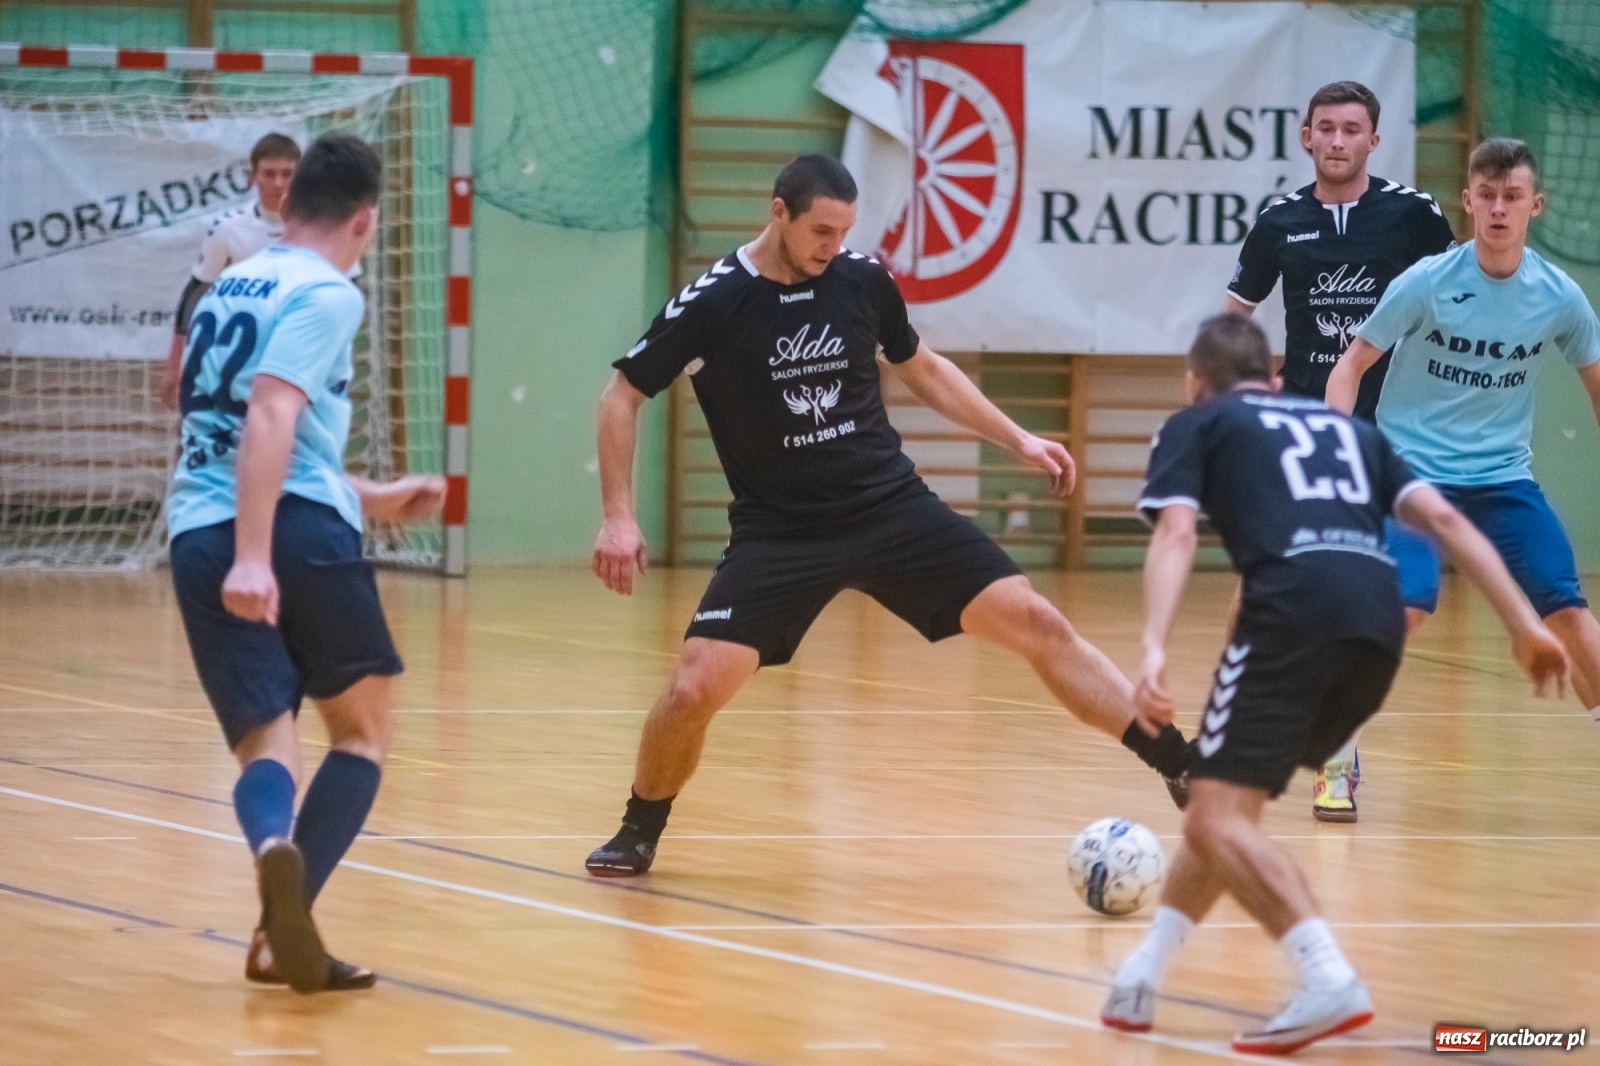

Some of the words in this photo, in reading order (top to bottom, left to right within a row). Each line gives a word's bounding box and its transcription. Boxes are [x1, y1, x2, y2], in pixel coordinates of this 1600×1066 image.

[1287, 230, 1319, 243] hummel
[1309, 264, 1376, 295] Ada
[779, 289, 814, 304] hummel
[1309, 297, 1334, 306] SALON
[1336, 296, 1377, 305] FRYZJERSKI
[768, 324, 845, 366] Ada
[179, 311, 257, 419] 22
[1317, 353, 1336, 363] 514
[771, 369, 801, 381] SALON
[803, 360, 849, 376] FRYZJERSKI
[793, 432, 815, 448] 514
[817, 428, 837, 443] 260
[838, 420, 856, 436] 902
[1258, 410, 1372, 505] 23
[693, 607, 732, 623] hummel
